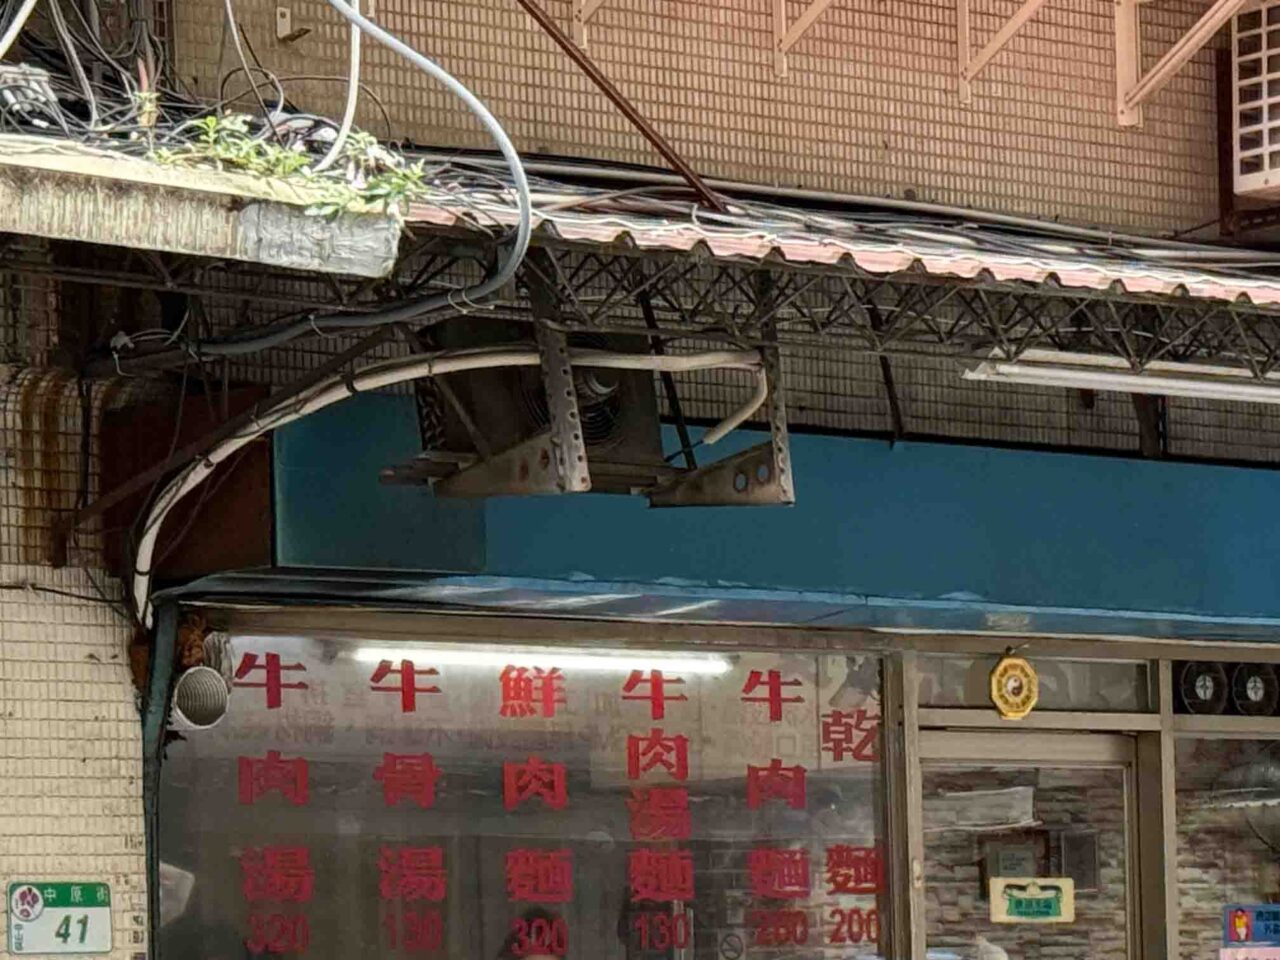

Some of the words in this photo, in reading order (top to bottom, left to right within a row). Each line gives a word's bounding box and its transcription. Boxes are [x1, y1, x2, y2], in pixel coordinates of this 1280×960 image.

[233, 652, 316, 904] 牛肉湯
[369, 659, 447, 902] 牛骨湯
[621, 669, 695, 901] 牛肉湯麵
[740, 669, 811, 899] 牛肉麵
[55, 913, 90, 944] 41
[634, 913, 690, 952] 130
